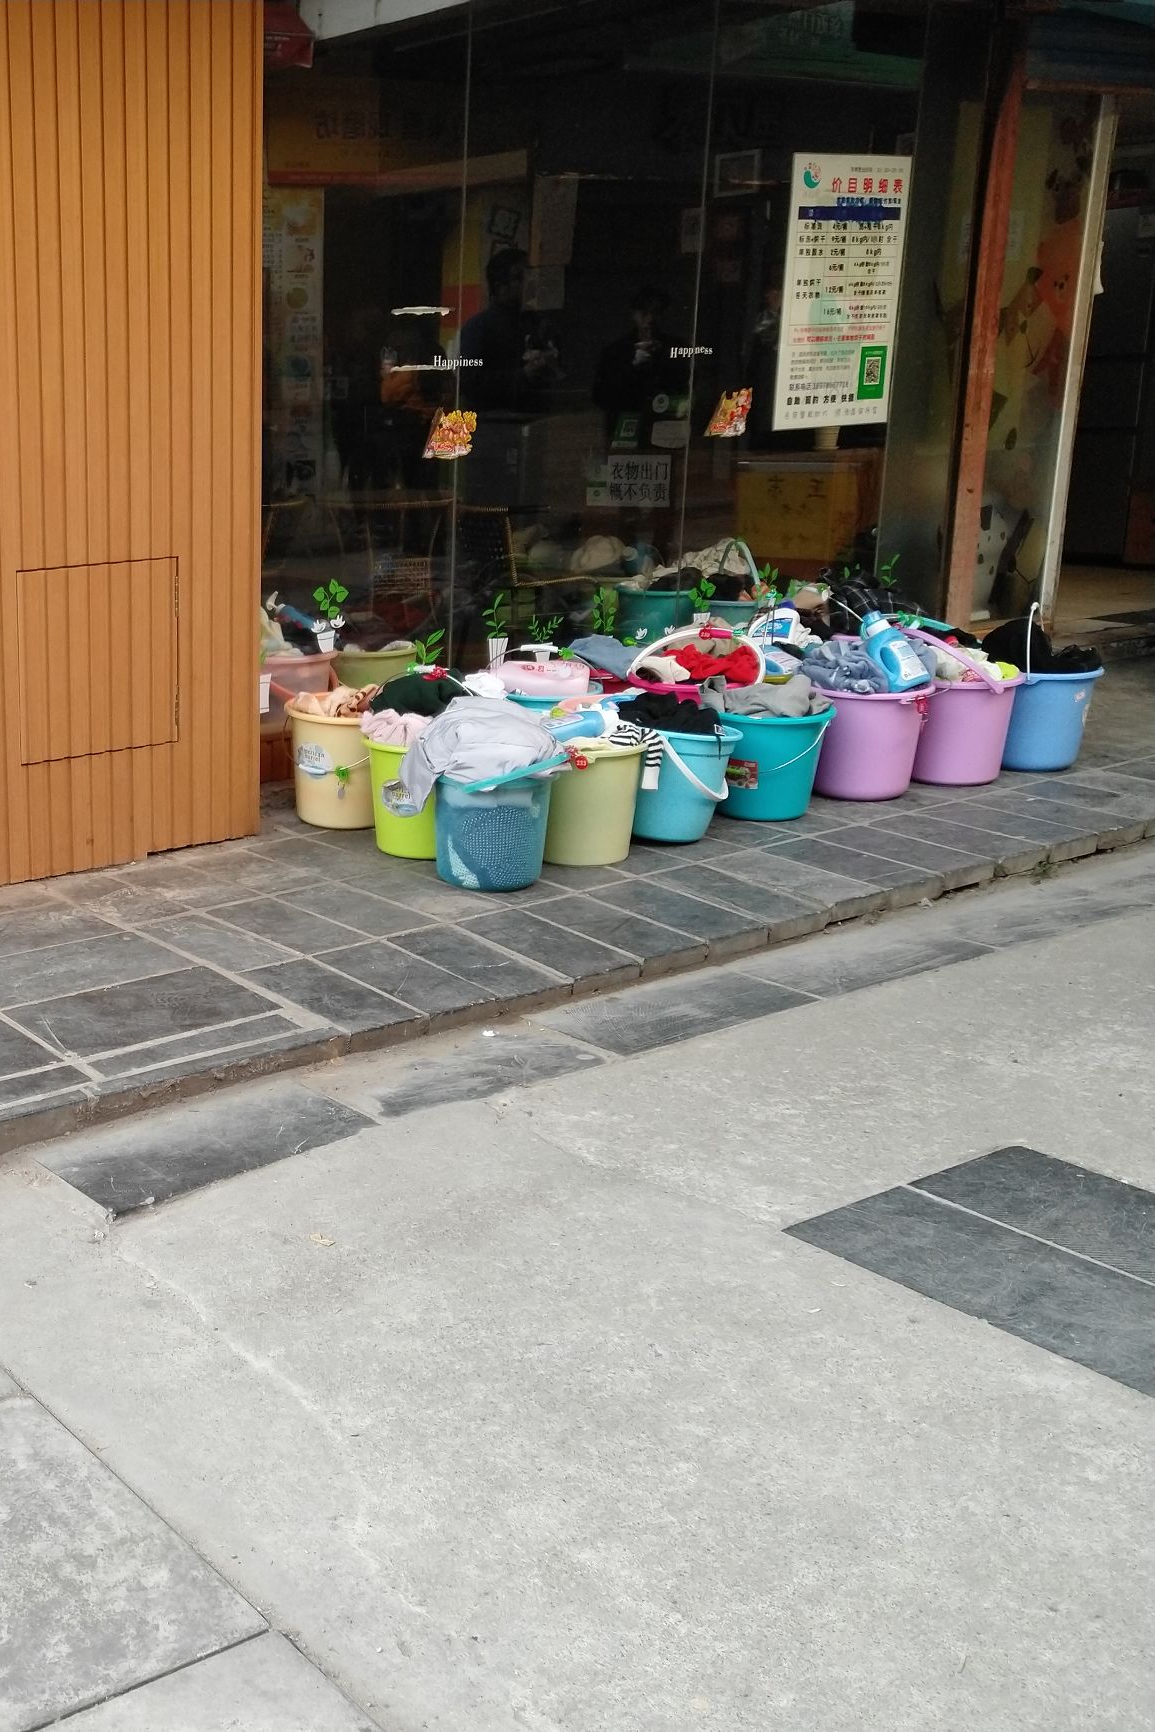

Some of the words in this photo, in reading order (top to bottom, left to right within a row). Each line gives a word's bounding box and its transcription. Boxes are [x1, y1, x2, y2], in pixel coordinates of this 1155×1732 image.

[831, 177, 903, 193] 价目明细表
[670, 346, 713, 358] Happness
[433, 355, 484, 369] Happiness
[613, 461, 668, 480] 衣物出门
[609, 482, 668, 501] 概不负责
